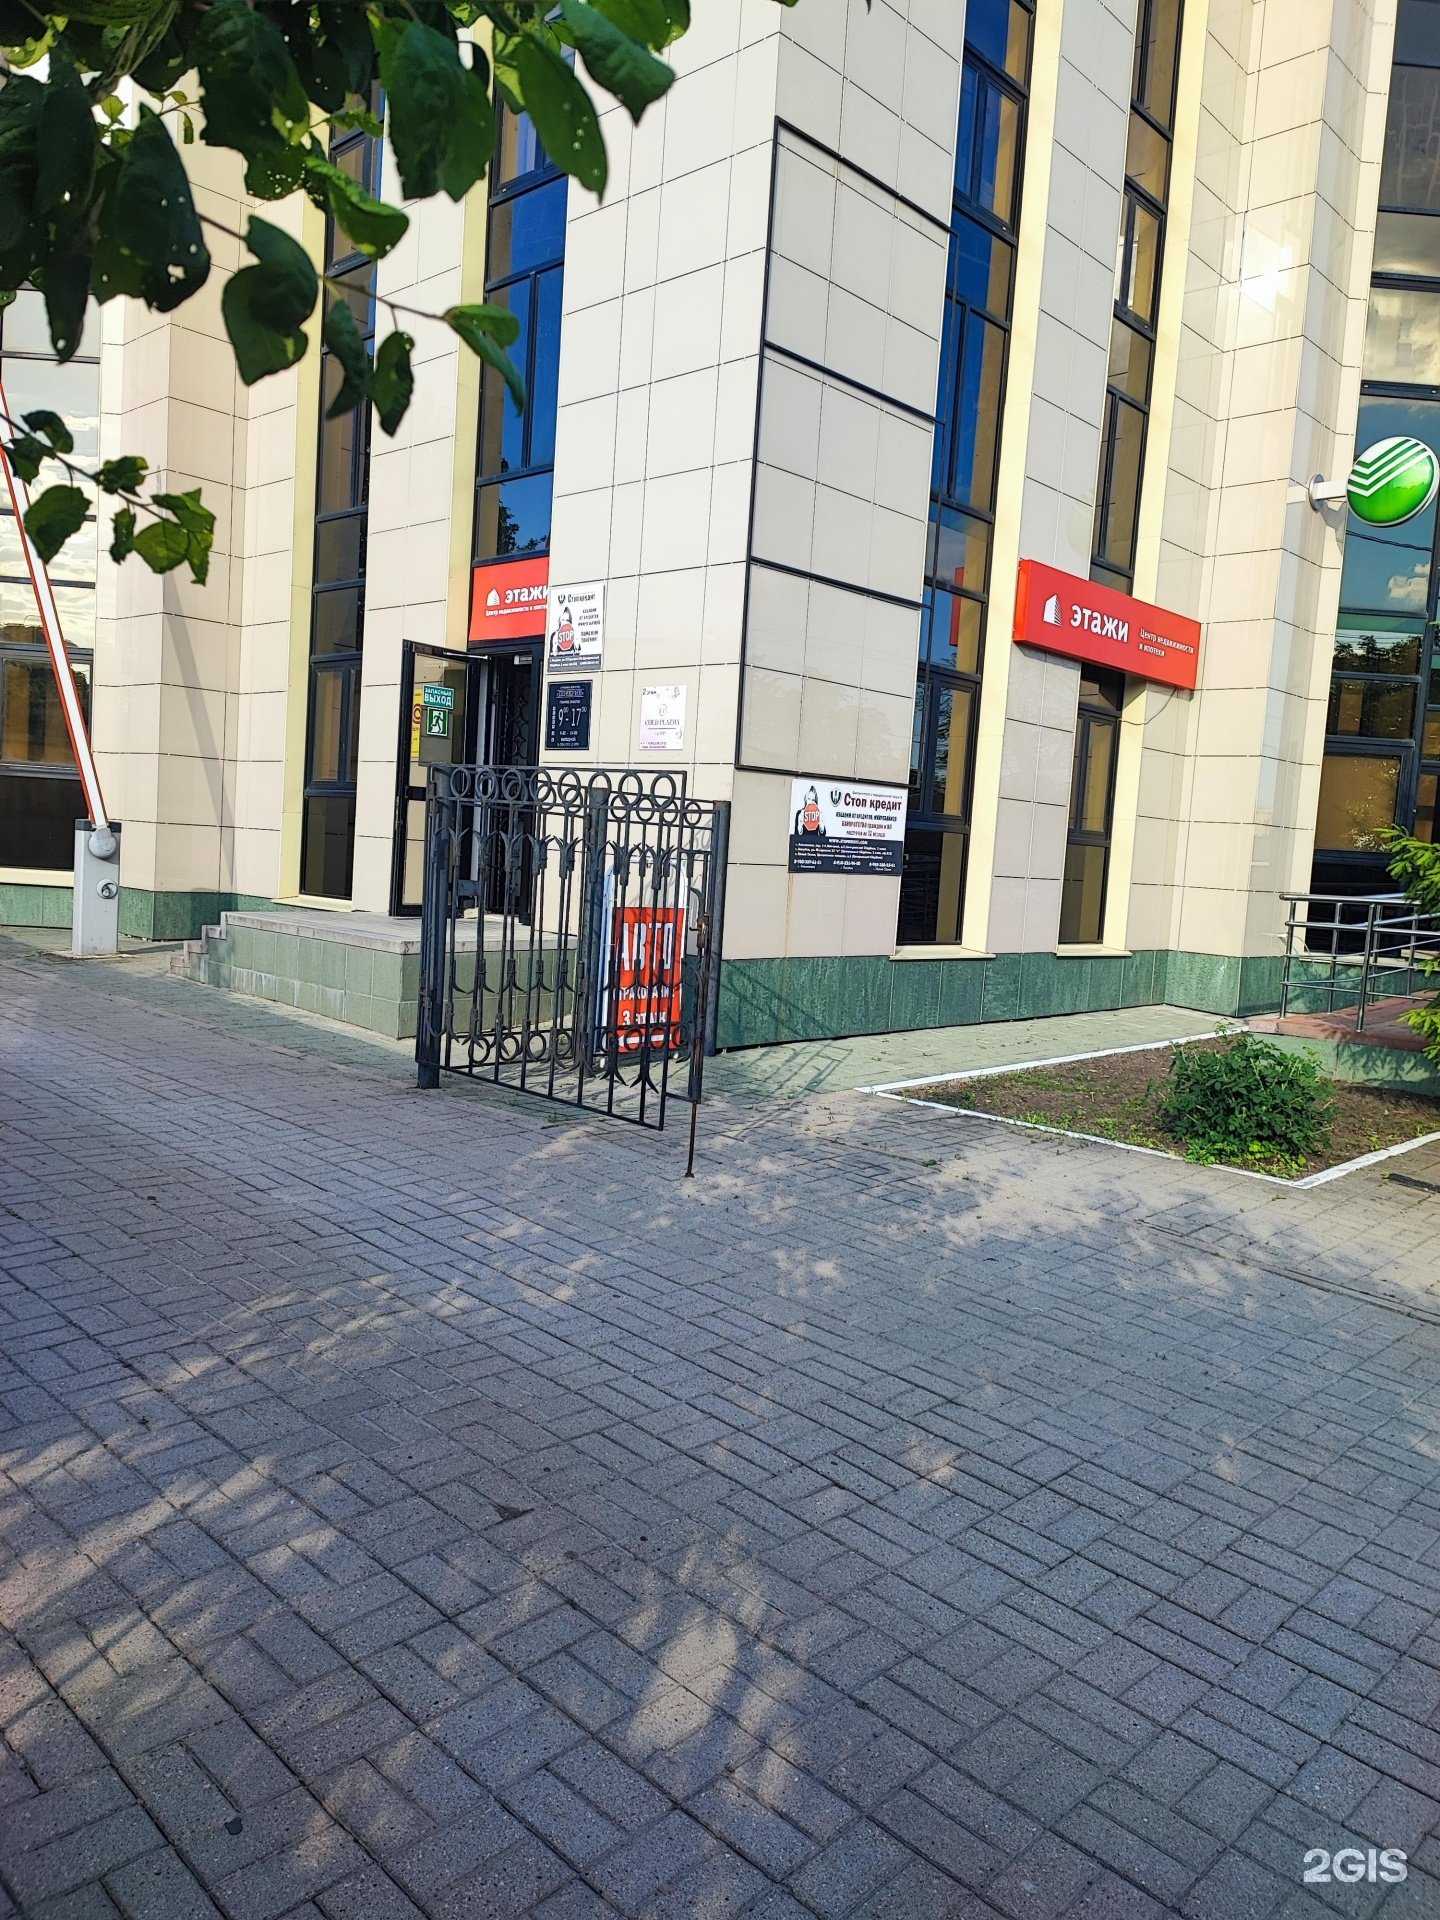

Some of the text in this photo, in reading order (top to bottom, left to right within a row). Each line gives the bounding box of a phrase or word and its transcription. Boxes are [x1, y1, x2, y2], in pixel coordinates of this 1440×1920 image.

[1070, 604, 1129, 643] этажи
[559, 631, 574, 642] STOP
[1140, 628, 1157, 643] Центр
[425, 693, 452, 707] ВЫХОД
[844, 792, 867, 808] Стоп
[869, 799, 902, 812] кредит
[804, 811, 820, 822] STOP
[615, 923, 674, 971] АВТО
